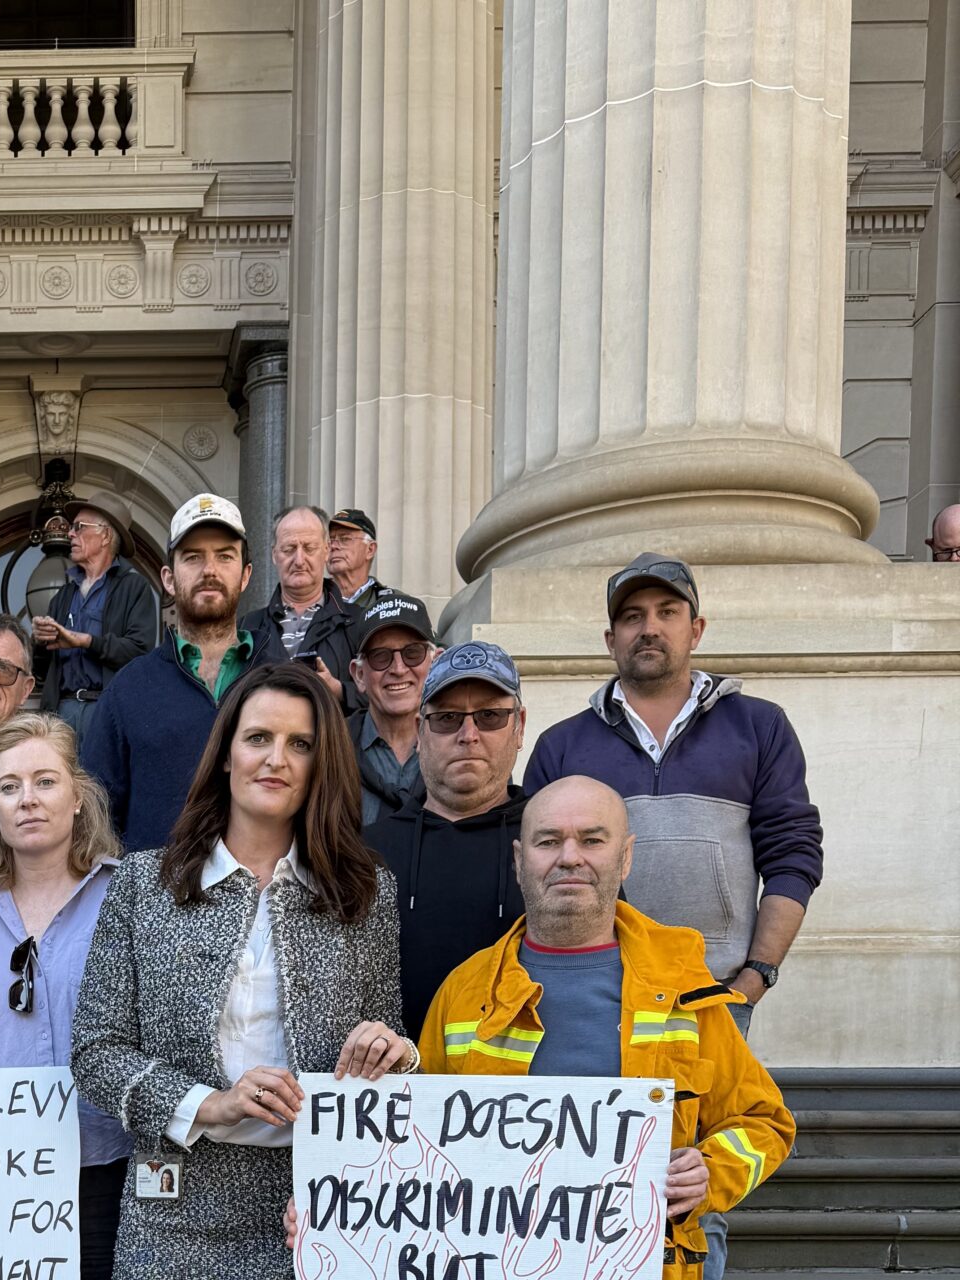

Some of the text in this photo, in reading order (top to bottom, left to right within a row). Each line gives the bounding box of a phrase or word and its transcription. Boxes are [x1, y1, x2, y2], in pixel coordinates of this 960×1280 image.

[379, 608, 401, 619] Beef
[394, 598, 418, 611] Howe
[311, 1088, 646, 1164] FIRE DOESN'T
[9, 1198, 74, 1233] FOR
[307, 1174, 633, 1244] DISCRIMINATE
